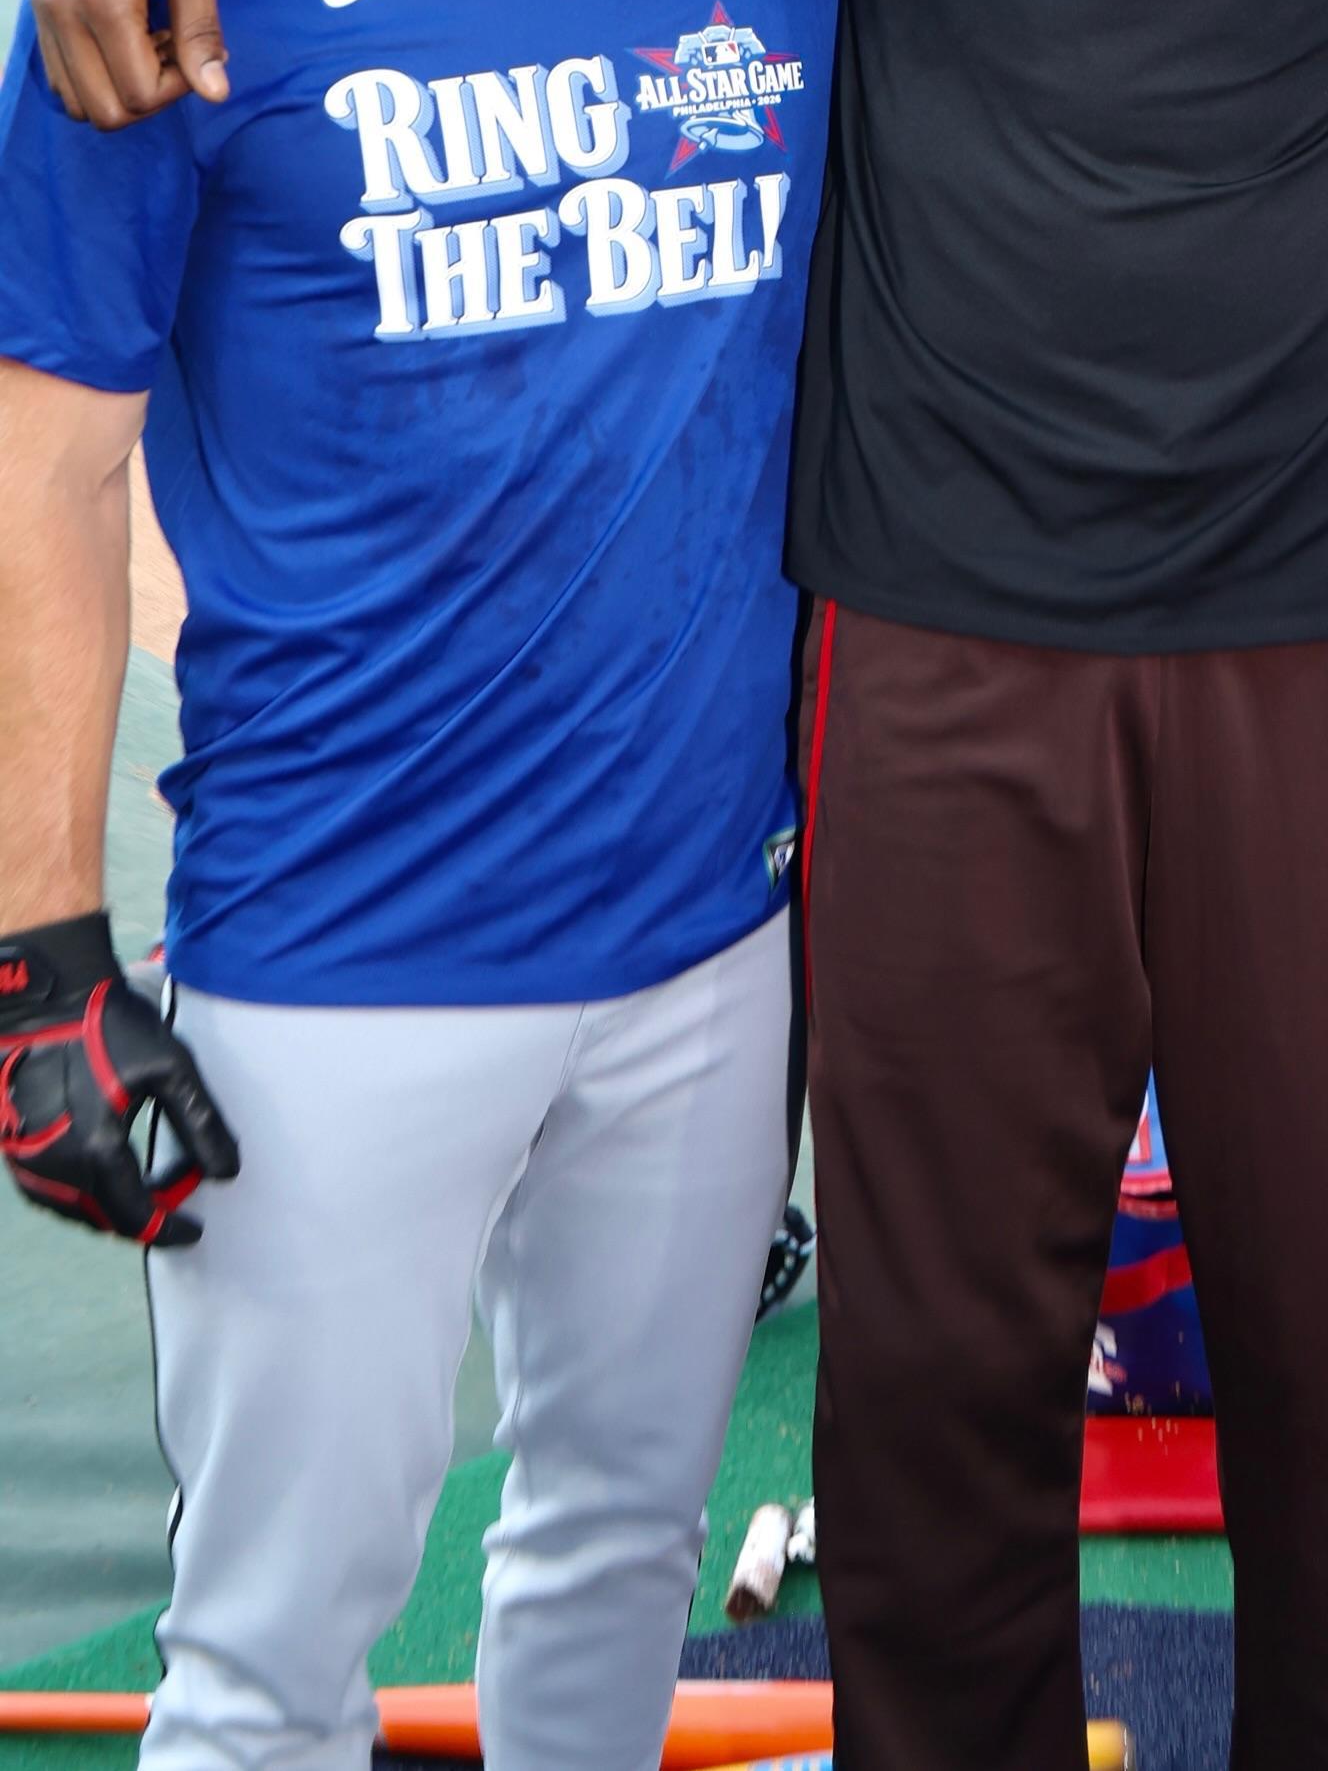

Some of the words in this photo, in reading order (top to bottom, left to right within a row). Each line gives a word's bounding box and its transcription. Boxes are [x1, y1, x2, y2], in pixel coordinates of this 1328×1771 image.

[636, 74, 689, 112] ALL
[686, 67, 750, 103] STAR
[747, 60, 805, 96] GAME
[672, 98, 752, 117] PHILADELPHIA
[757, 93, 782, 108] 2026
[324, 55, 631, 214] RING
[340, 205, 568, 344] THE
